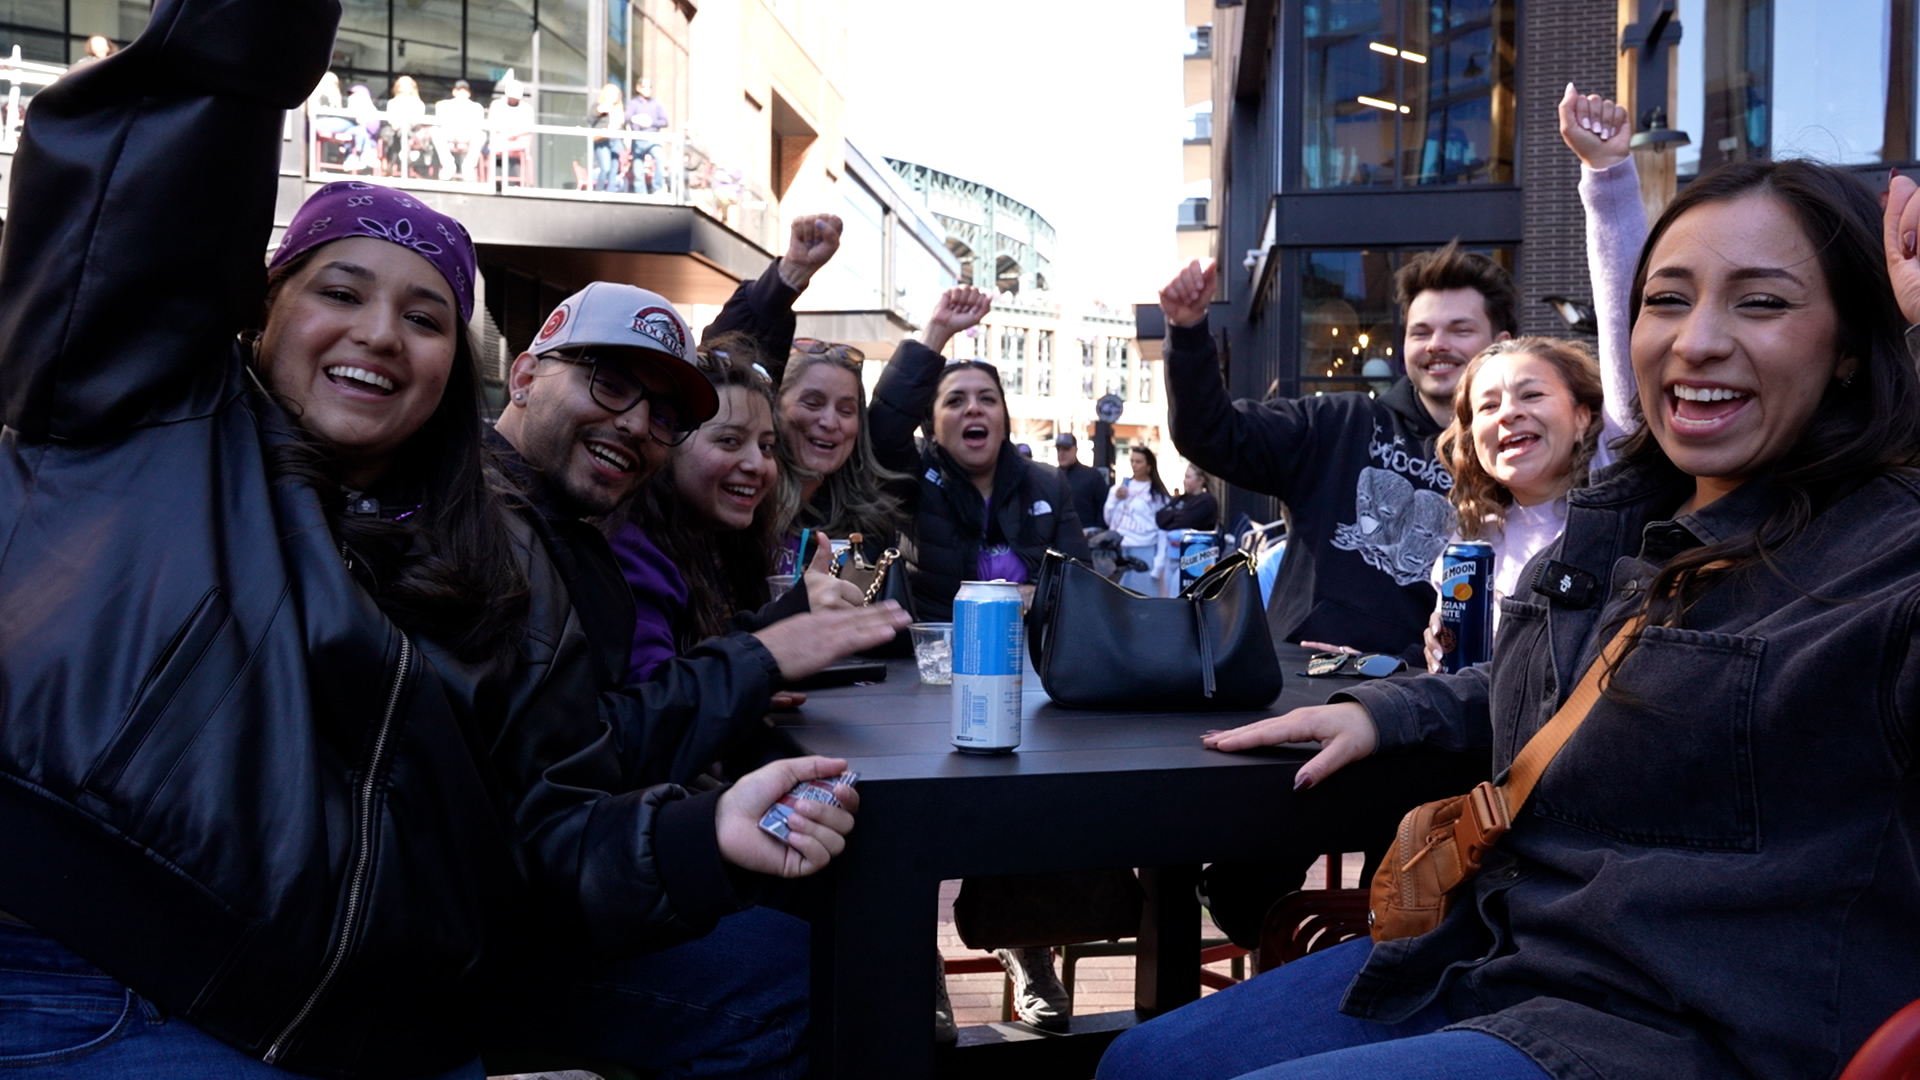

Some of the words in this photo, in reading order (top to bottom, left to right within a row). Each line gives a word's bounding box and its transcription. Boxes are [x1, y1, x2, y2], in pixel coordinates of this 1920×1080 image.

[633, 319, 685, 359] ROCKIES
[1449, 564, 1475, 578] MOON
[1442, 610, 1460, 618] HITE
